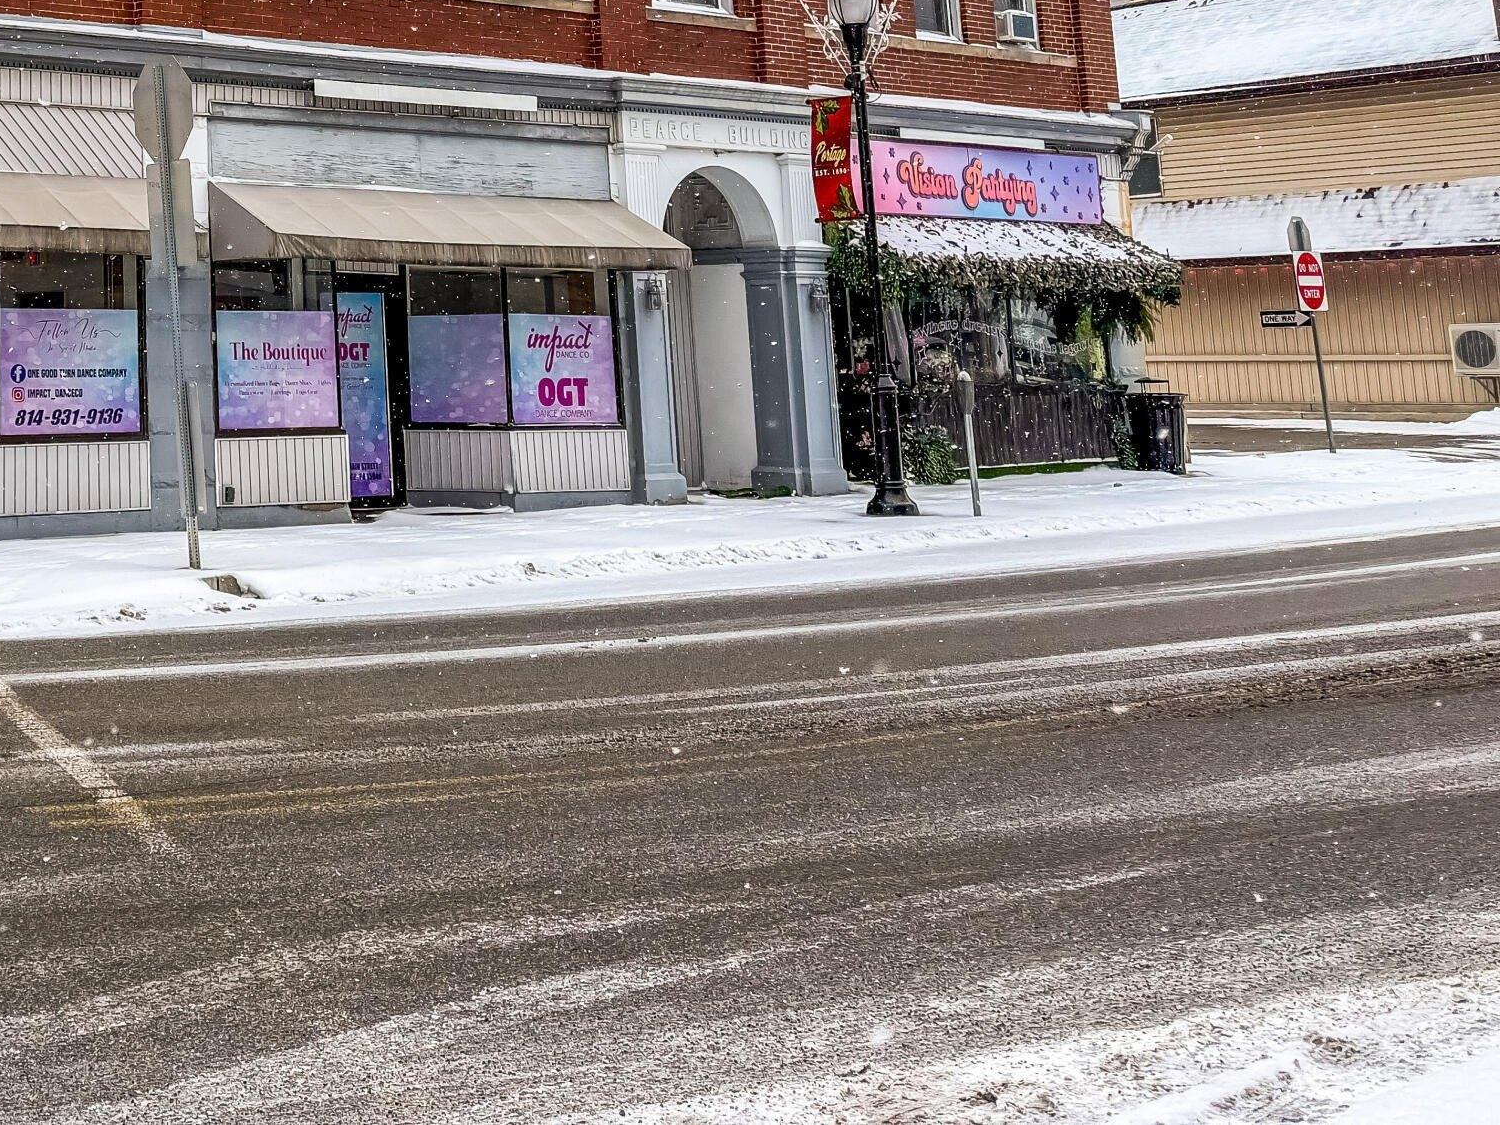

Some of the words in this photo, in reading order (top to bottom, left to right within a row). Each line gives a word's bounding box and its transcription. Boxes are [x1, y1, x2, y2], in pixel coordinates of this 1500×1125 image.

[629, 117, 702, 142] PEARCE
[728, 124, 810, 149] BUILDING
[815, 141, 847, 168] Portage
[815, 169, 830, 177] EST.
[896, 151, 958, 199] Vision
[961, 157, 1038, 217] Partying
[1299, 264, 1307, 273] DO
[1308, 263, 1319, 273] NOT
[1304, 289, 1321, 299] ENTER
[1264, 315, 1279, 323] ONE
[527, 320, 593, 372] impact
[229, 341, 258, 361] The
[262, 341, 327, 367] Boutique
[555, 351, 577, 359] DANCE
[27, 369, 40, 378] ONE
[41, 369, 58, 378] GOOD
[77, 369, 97, 378] DANCE
[98, 368, 128, 378] COMPANY
[538, 377, 589, 407] OGT
[14, 407, 124, 426] 814-931-9136
[534, 409, 558, 418] DANCE
[560, 409, 593, 418] COMPANY
